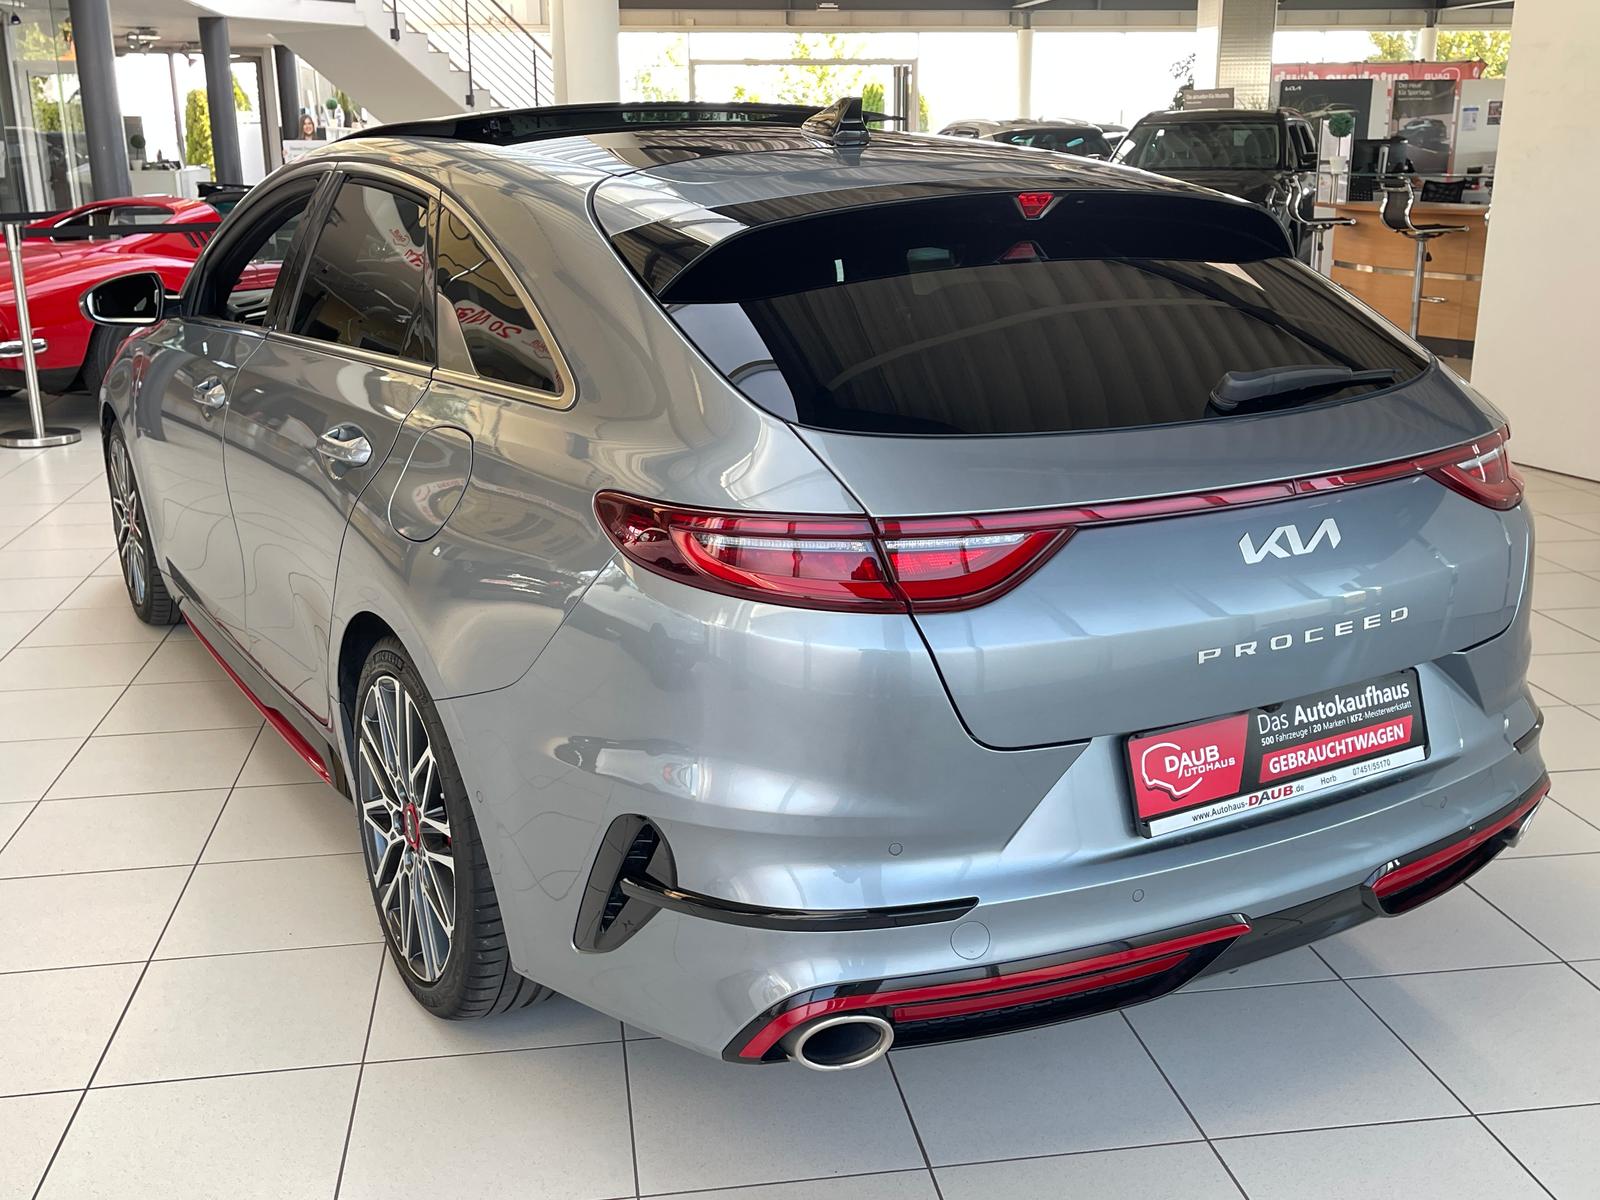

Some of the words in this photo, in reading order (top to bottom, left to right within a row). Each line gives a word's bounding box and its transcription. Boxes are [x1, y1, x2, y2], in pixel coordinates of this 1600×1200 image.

[1238, 518, 1341, 565] KIA
[1198, 606, 1409, 665] PROCEED
[1257, 713, 1289, 735] Das
[1294, 682, 1410, 726] Autokaufhaus
[1261, 735, 1275, 747] 500
[1275, 728, 1309, 743] Fahrzeuge
[1312, 724, 1322, 733] 20
[1322, 718, 1346, 731] Marken
[1350, 700, 1412, 724] KFZ-Meisterwerkstatt
[1164, 745, 1220, 779] DAUB
[1269, 723, 1405, 774] GEBRAUCHTWAGEN
[1320, 774, 1337, 786] Horb
[1352, 758, 1391, 776] 07451/55170
